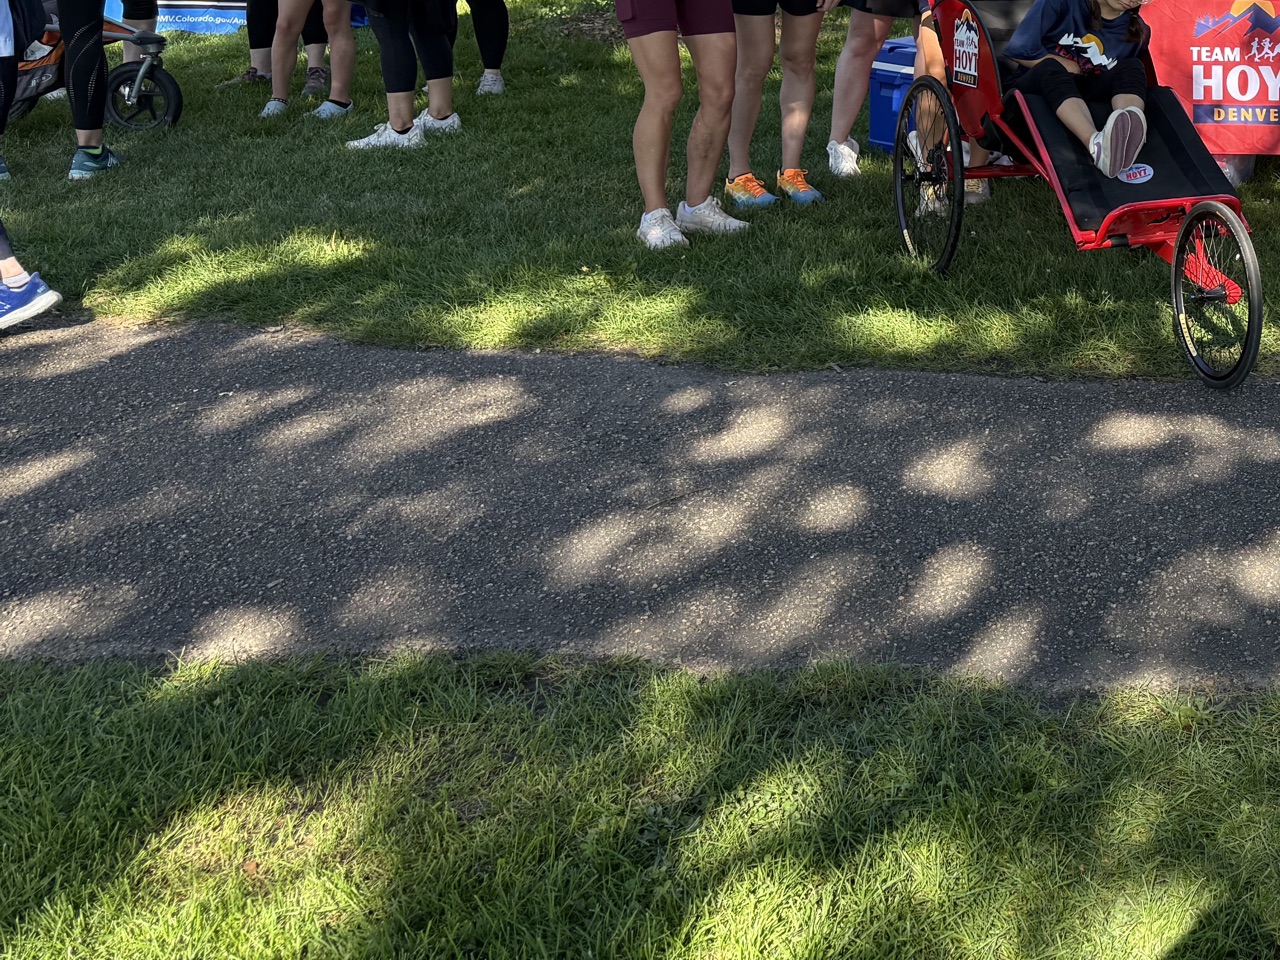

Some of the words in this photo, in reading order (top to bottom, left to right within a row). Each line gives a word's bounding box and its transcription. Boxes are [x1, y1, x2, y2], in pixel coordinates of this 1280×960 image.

[955, 39, 965, 48] TEAM
[1190, 46, 1240, 61] TEAM
[954, 49, 977, 72] HOYT
[957, 73, 974, 84] DENVER
[1125, 169, 1147, 180] HOYT
